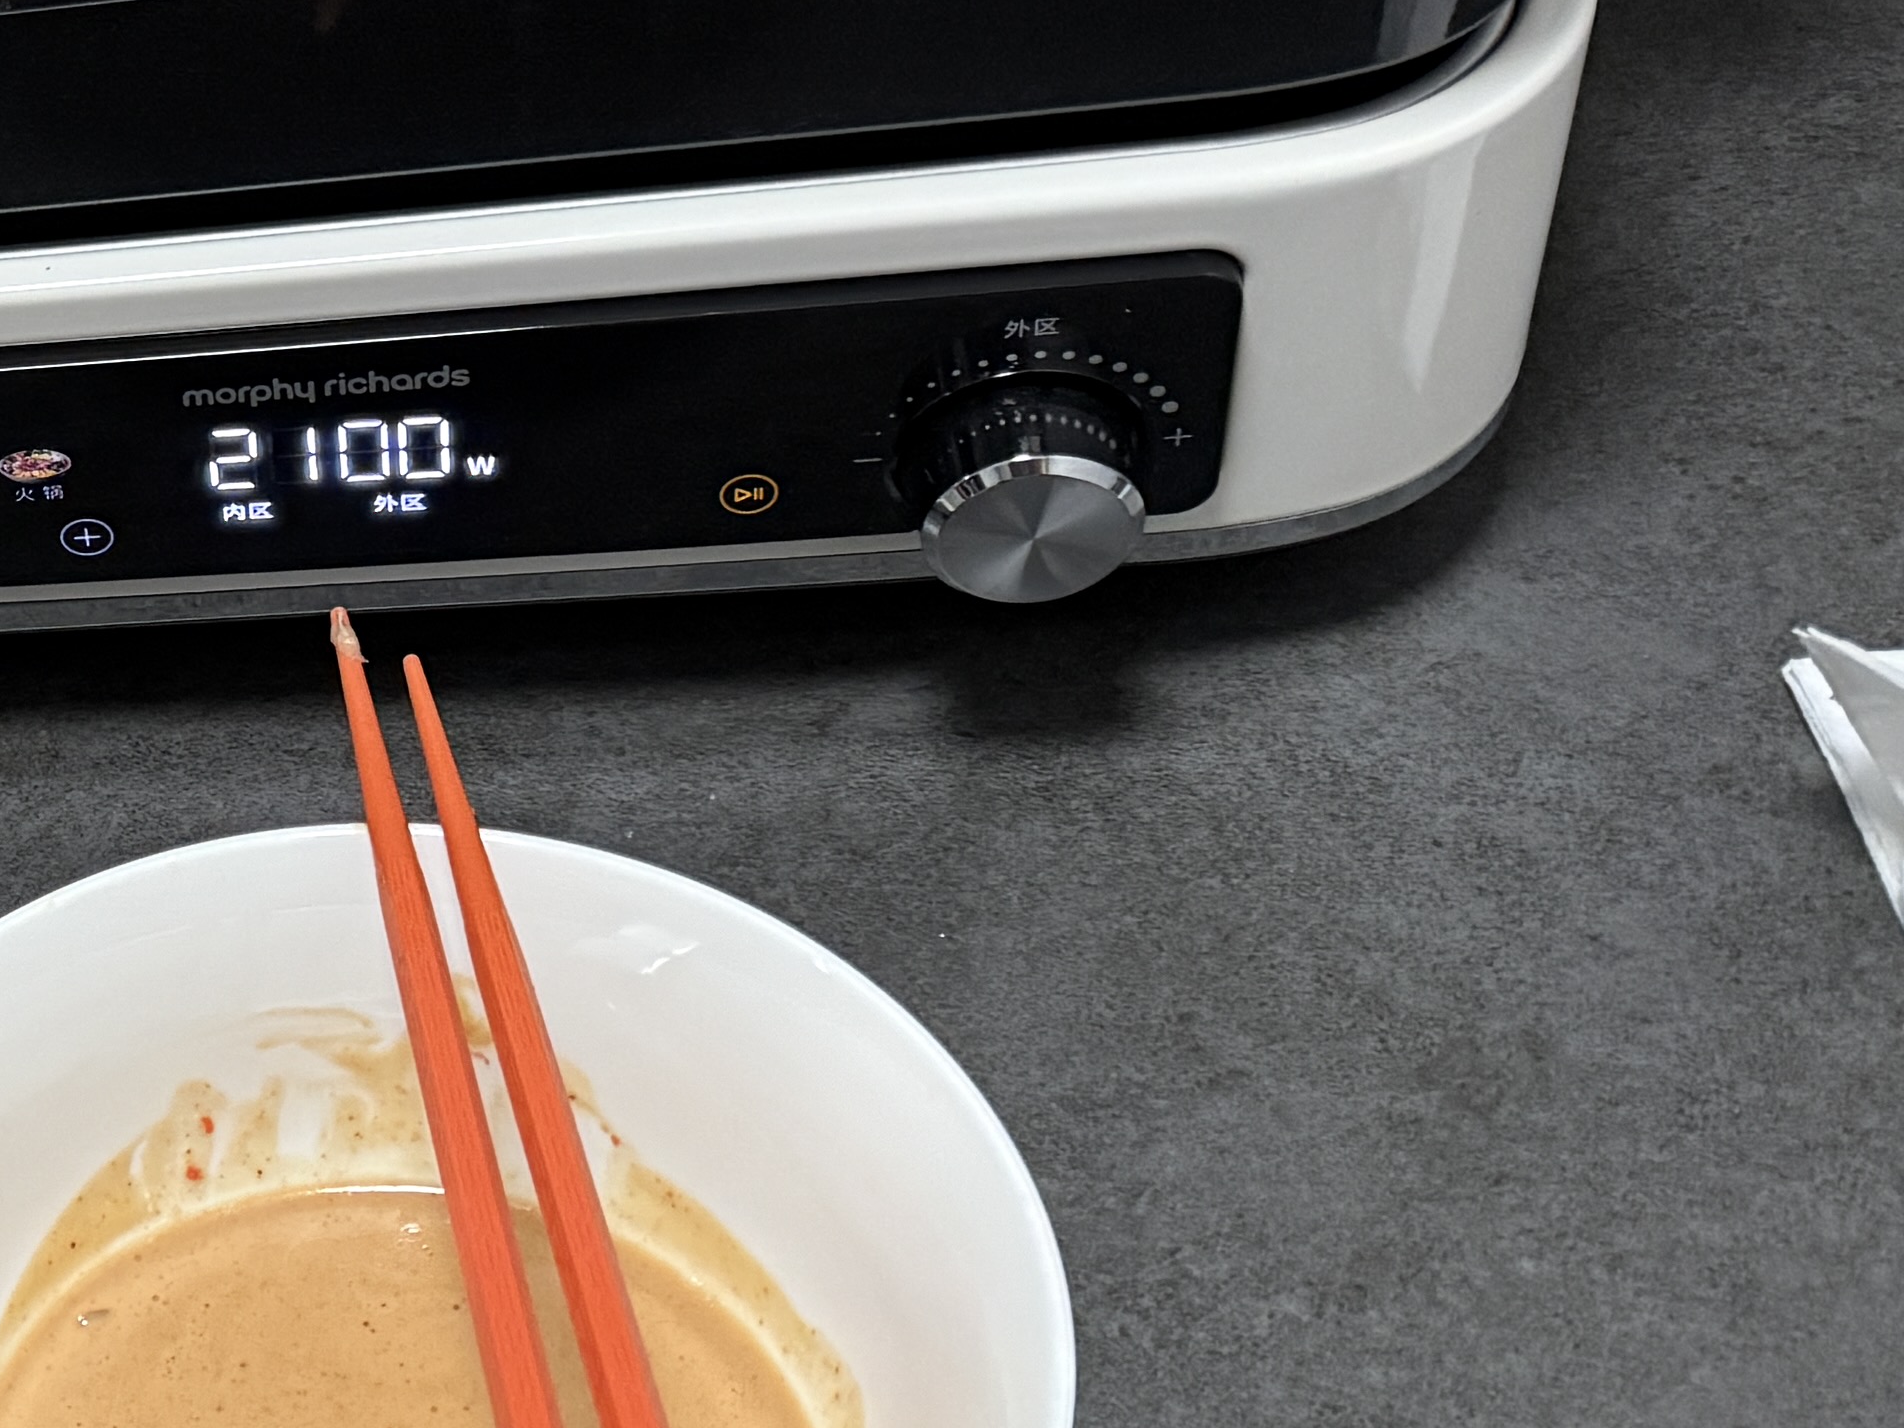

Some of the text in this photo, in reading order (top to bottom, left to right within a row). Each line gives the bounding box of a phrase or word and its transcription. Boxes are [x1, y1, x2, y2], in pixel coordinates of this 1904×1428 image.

[1003, 317, 1061, 339] 外区
[181, 365, 472, 409] morphy richards
[207, 414, 452, 493] 2100
[221, 500, 275, 523] 内区
